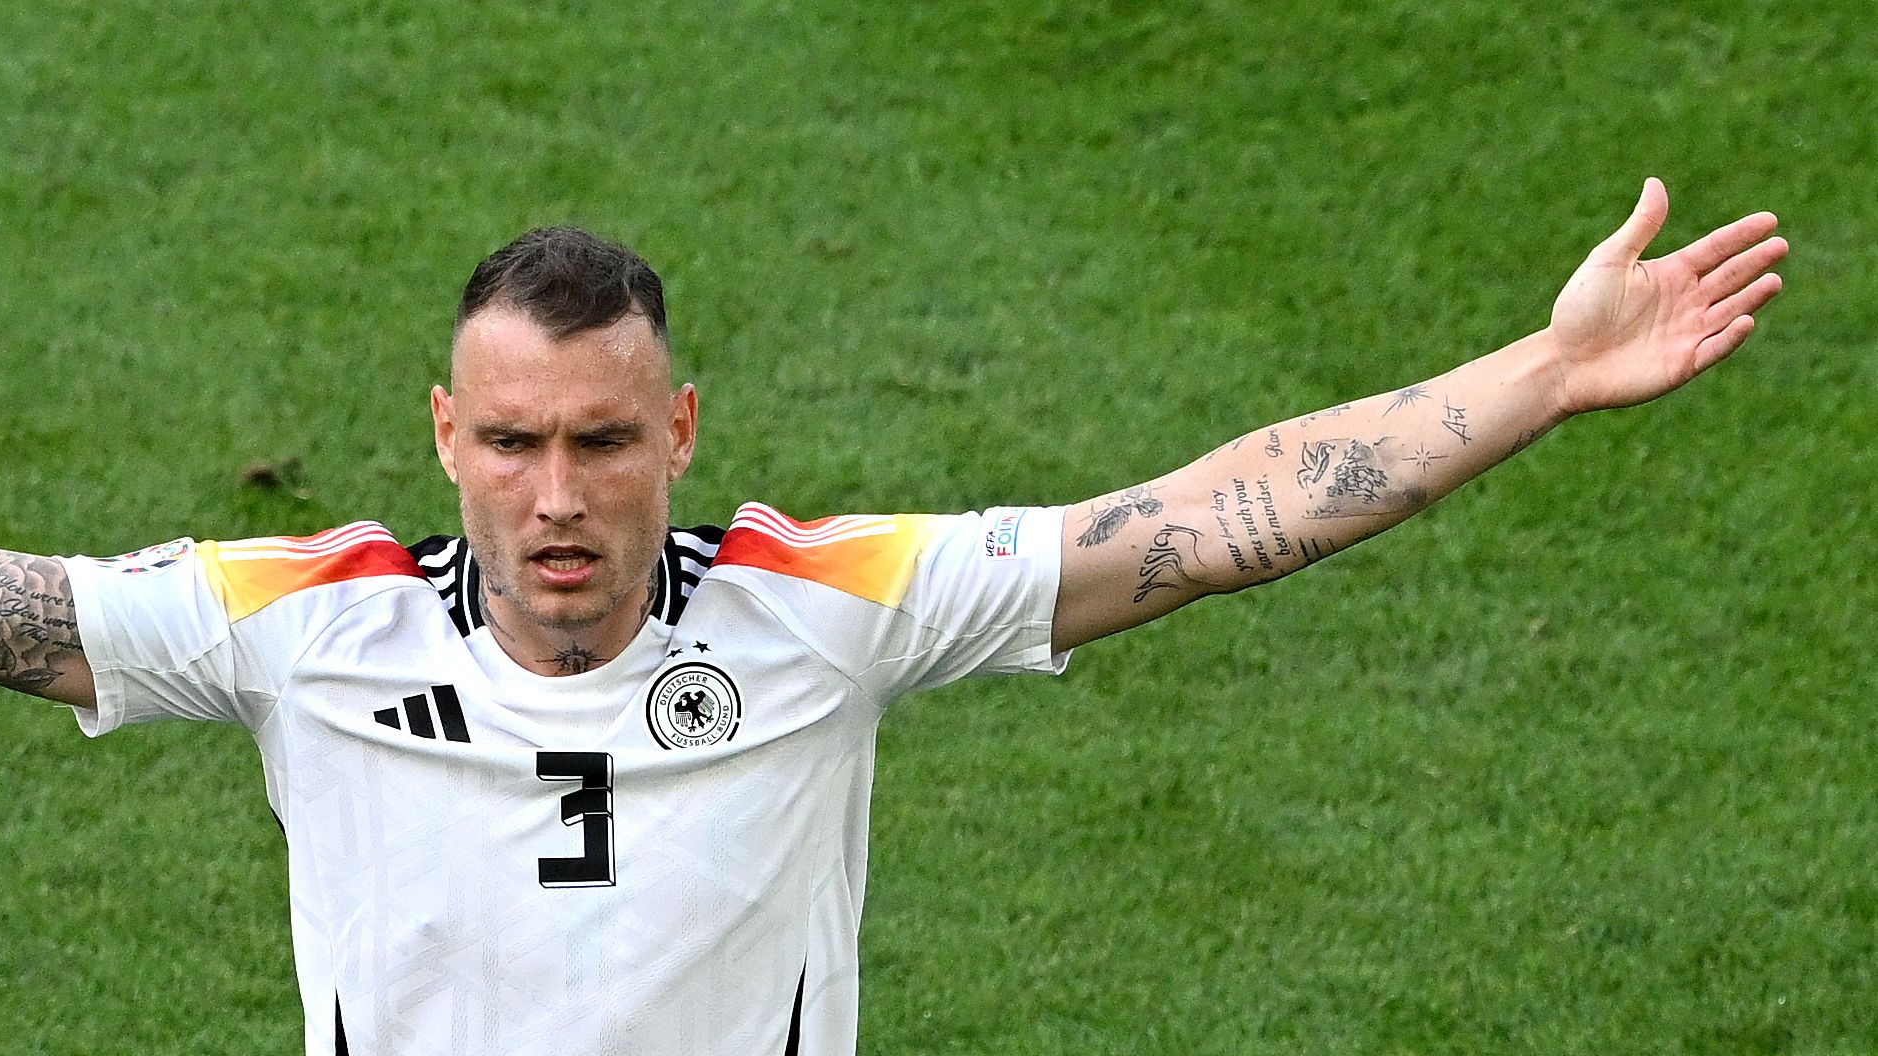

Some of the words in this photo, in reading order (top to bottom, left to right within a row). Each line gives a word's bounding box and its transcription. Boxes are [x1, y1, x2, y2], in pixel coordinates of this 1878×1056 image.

[1232, 478, 1254, 506] your
[1273, 531, 1291, 556] best
[659, 674, 708, 706] DEUTSCHER
[536, 751, 616, 888] 3
